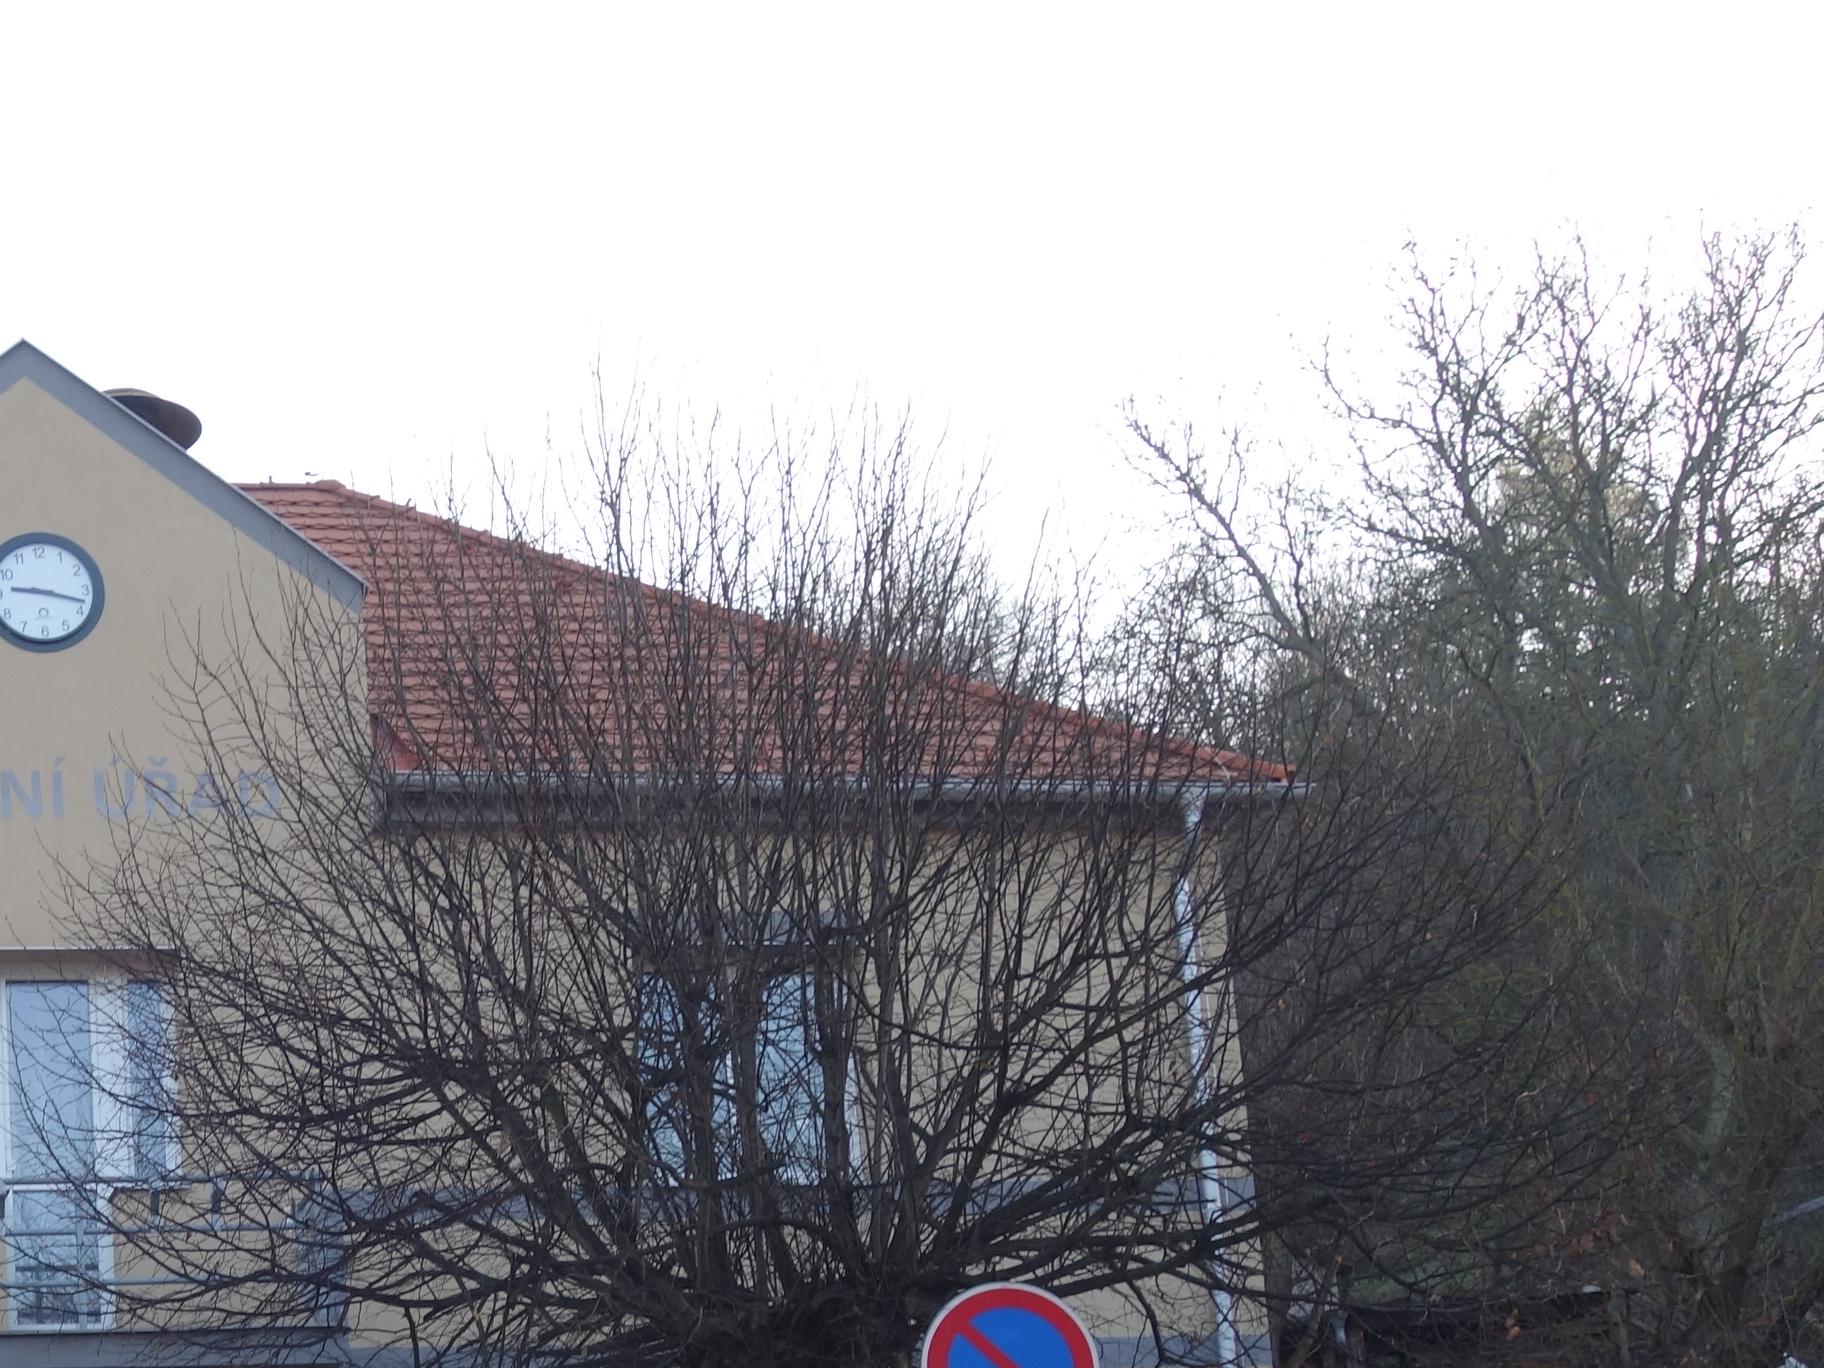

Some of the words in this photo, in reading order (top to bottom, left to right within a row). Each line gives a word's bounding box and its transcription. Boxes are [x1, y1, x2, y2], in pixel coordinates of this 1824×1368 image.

[14, 552, 24, 565] 11
[32, 546, 45, 559] 12
[57, 551, 63, 564] 1
[0, 568, 14, 581] 10
[72, 564, 81, 577] 2
[81, 584, 90, 596] 3
[3, 607, 12, 620] 8
[76, 604, 84, 617] 4
[20, 620, 28, 633] 7
[41, 625, 49, 638] 6
[61, 619, 70, 631] 5
[93, 755, 282, 819] ÚŘAD
